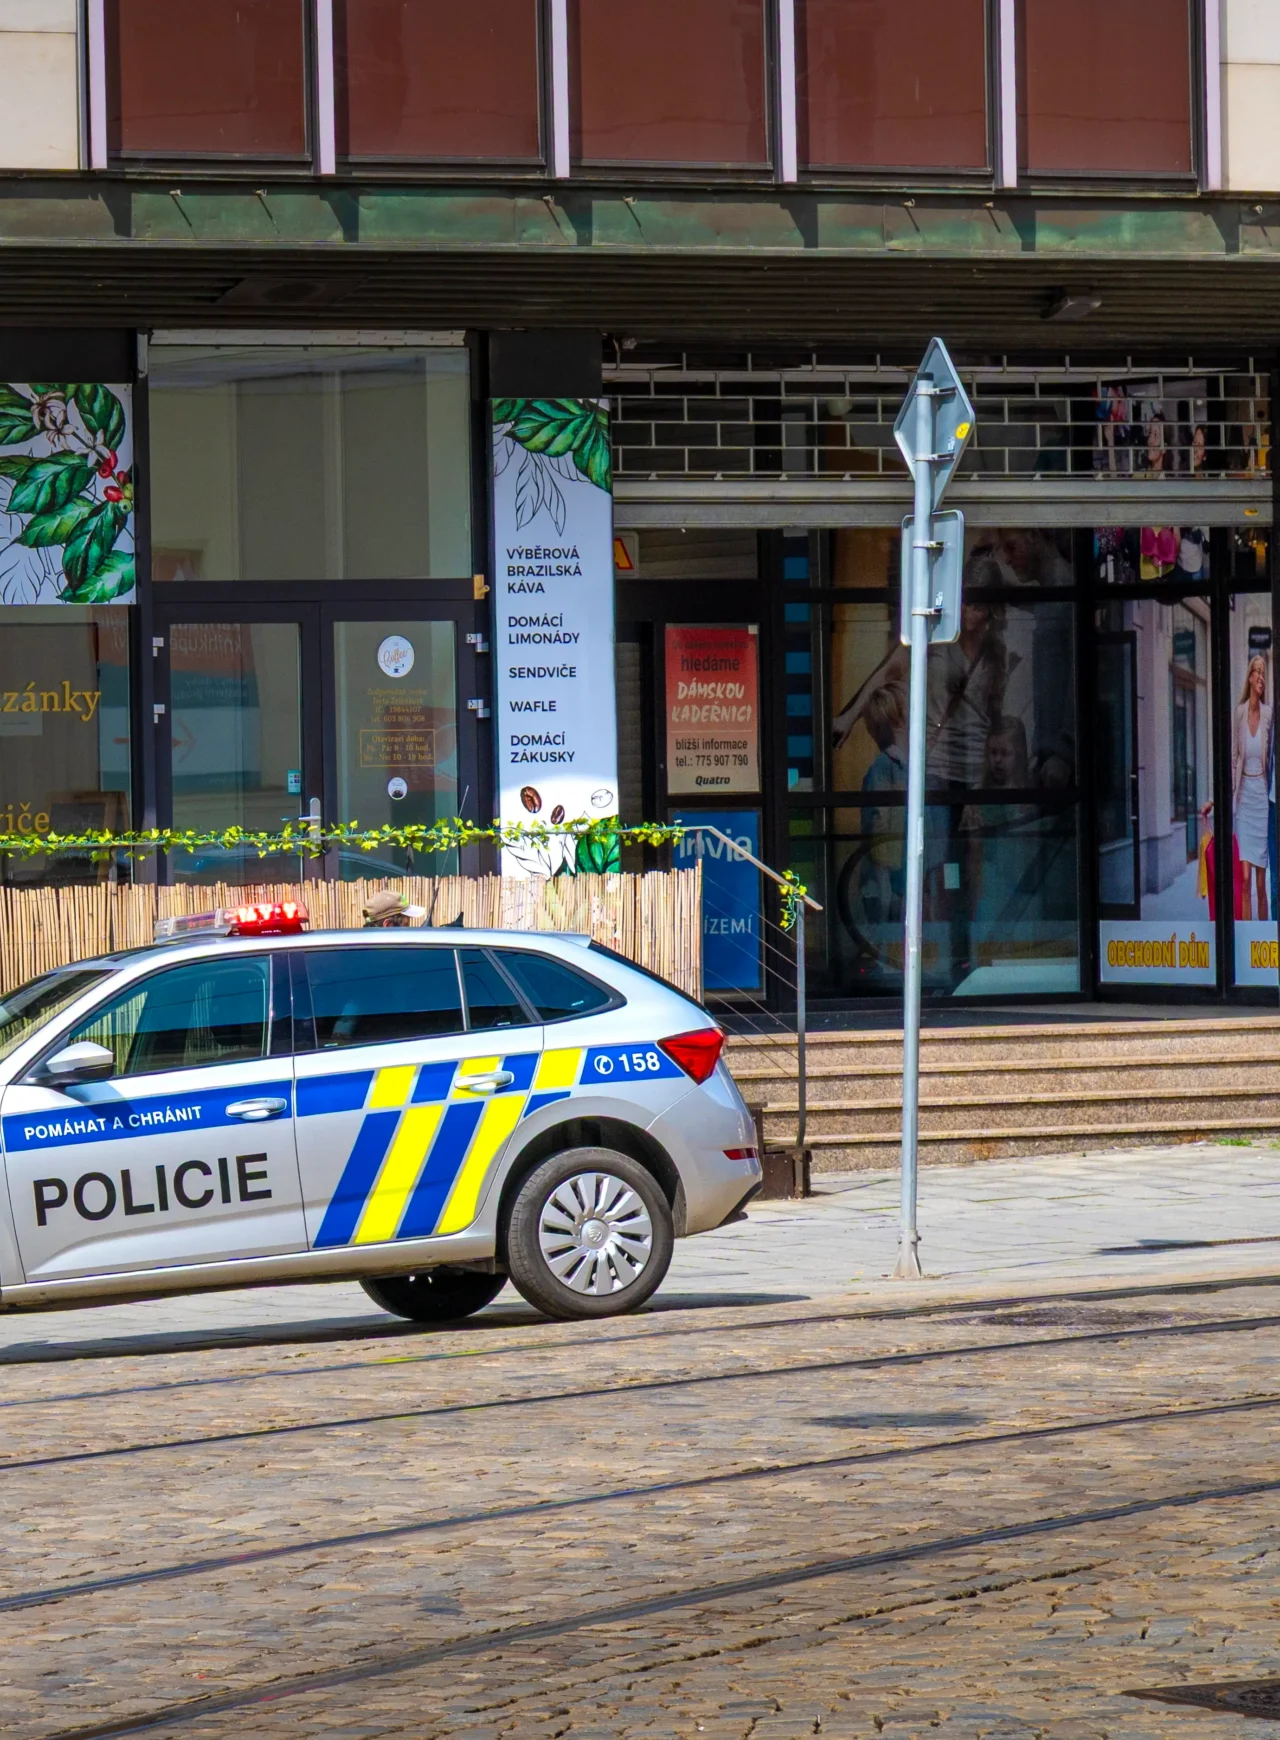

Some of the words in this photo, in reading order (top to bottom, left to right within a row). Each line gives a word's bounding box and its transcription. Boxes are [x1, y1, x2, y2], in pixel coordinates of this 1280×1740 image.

[506, 545, 580, 560] VÝBĚROVÁ
[507, 562, 582, 577] BRAZILSKÁ
[507, 579, 546, 594] KÁVA
[508, 613, 563, 628] DOMÁCÍ
[508, 630, 580, 645] LIMONÁDY
[509, 663, 577, 678] SENDVIČE
[677, 677, 745, 700] DÁMSKOU
[509, 700, 557, 712] WAFLE
[671, 701, 752, 723] KADEŘNICI
[510, 731, 566, 746] DOMÁCÍ
[702, 738, 748, 750] informace
[510, 748, 575, 763] ZÁKUSKY
[695, 755, 712, 767] 775
[713, 755, 729, 767] 907
[732, 754, 749, 766] 790
[695, 775, 731, 786] Quatro
[1107, 933, 1176, 968] OBCHODNÍ
[1179, 932, 1210, 968] DŮM
[618, 1051, 660, 1072] 158
[24, 1118, 107, 1140] POMÁHAT
[113, 1116, 124, 1130] A
[128, 1106, 202, 1128] CHRÁNIT
[32, 1152, 273, 1227] POLICIE
